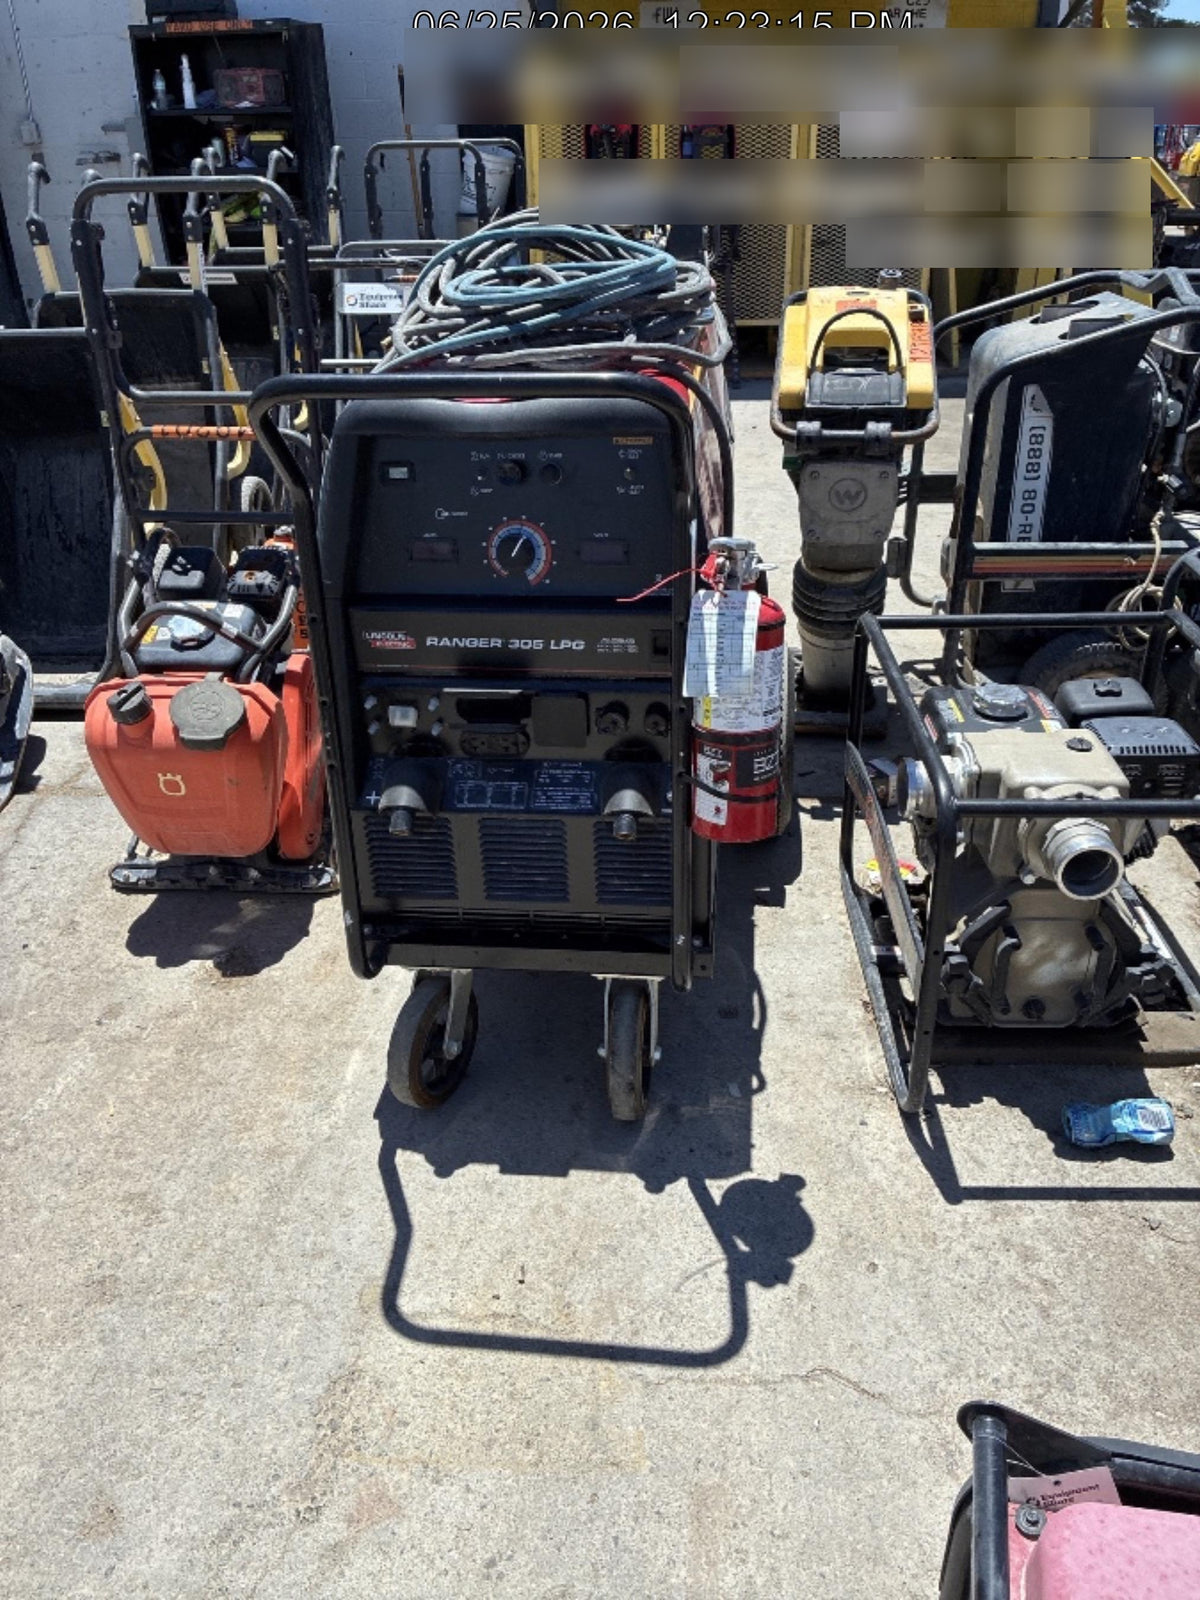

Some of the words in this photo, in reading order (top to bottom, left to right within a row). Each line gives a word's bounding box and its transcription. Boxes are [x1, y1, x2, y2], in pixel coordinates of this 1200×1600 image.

[1023, 426, 1047, 482] (888)
[425, 636, 502, 650] RANGER
[507, 638, 544, 650] 305
[550, 639, 586, 651] LPG
